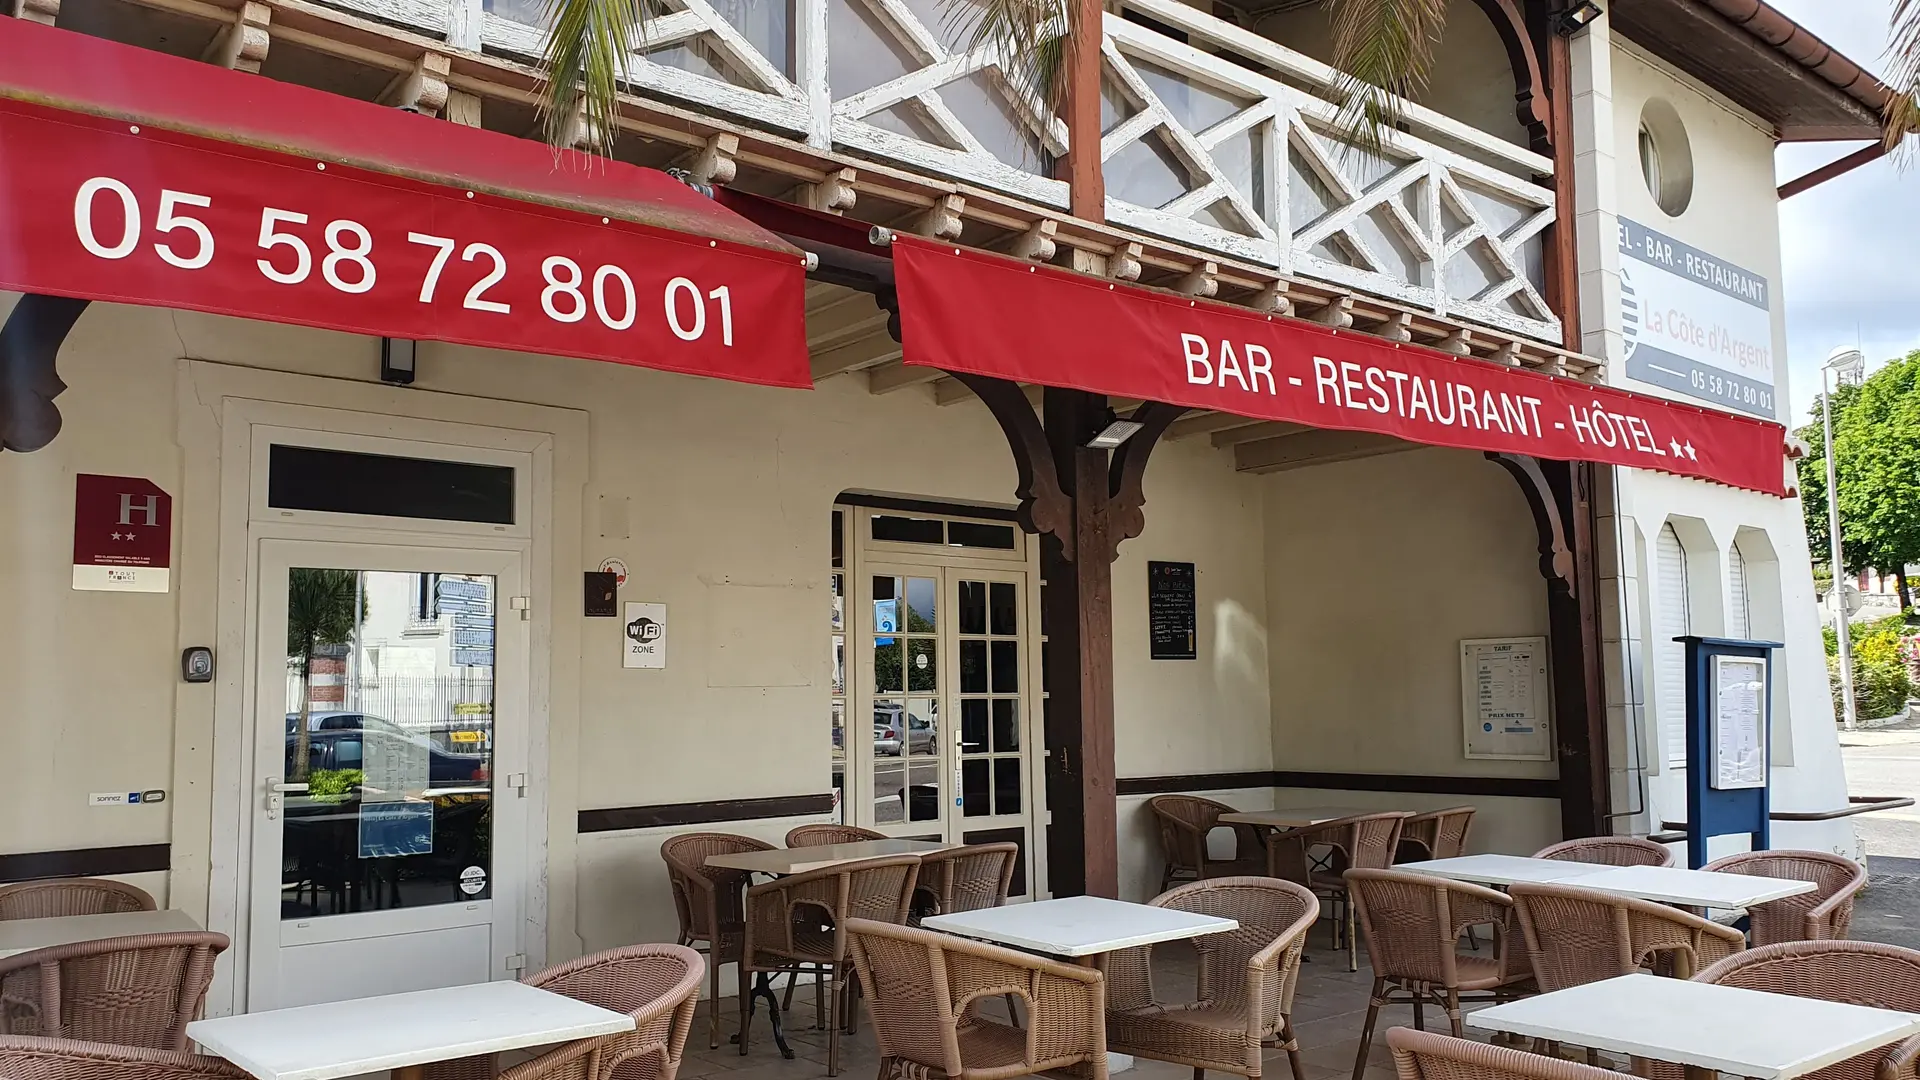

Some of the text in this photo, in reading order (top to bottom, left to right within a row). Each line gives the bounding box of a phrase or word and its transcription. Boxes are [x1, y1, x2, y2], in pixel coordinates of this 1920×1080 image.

[75, 177, 733, 347] 05 58 72 80 01
[1646, 235, 1674, 267] BAR
[1686, 253, 1763, 302] RESTAURANT
[1645, 299, 1770, 370] La Côte d'Argent
[1181, 333, 1277, 395] BAR
[1313, 357, 1542, 439] RESTAURANT
[1570, 400, 1667, 457] HÔTEL
[1692, 369, 1773, 410] 05 58 72 80 01
[115, 493, 161, 526] H
[632, 646, 655, 654] ZONE
